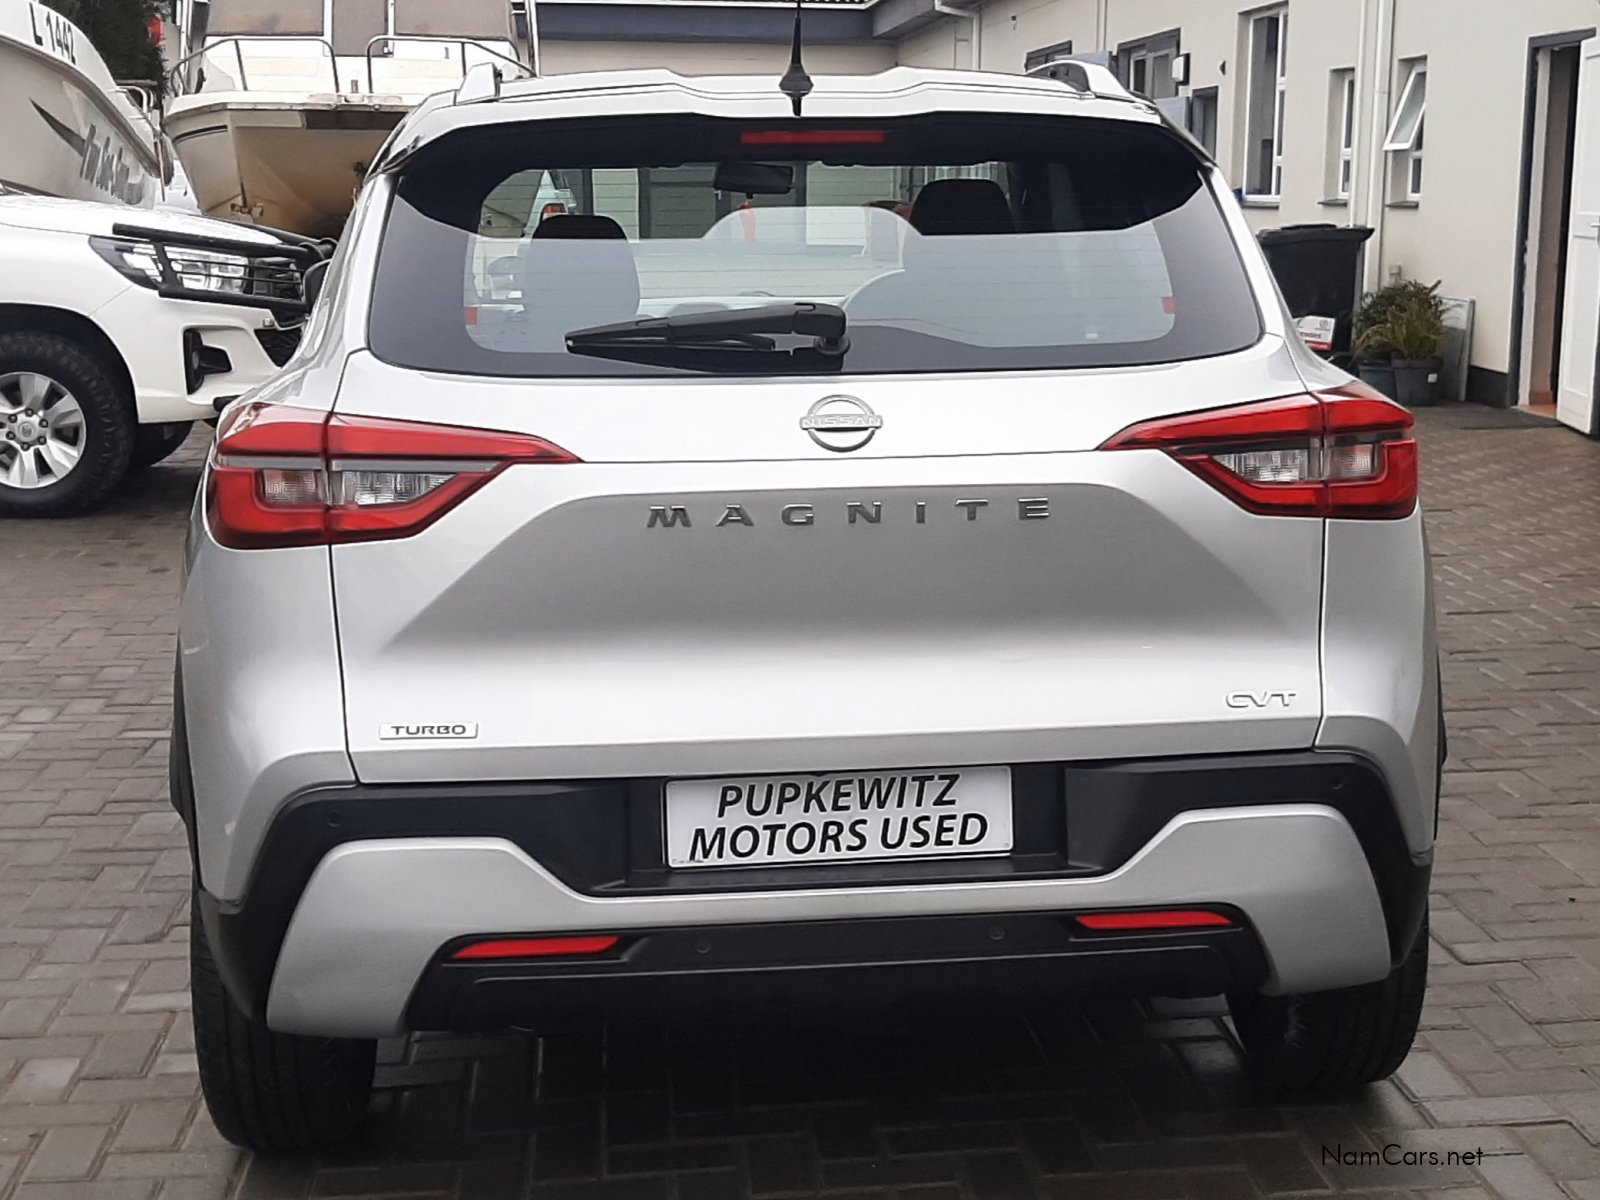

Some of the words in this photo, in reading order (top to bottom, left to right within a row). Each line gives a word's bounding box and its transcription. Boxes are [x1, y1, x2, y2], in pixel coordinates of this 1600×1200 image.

[29, 2, 44, 47] L
[46, 11, 76, 66] 1442
[801, 415, 881, 429] NISSAN
[646, 496, 1051, 528] MAGNITE
[1225, 690, 1297, 709] CVT
[390, 724, 467, 736] TURBO
[717, 773, 961, 818] PUPKEWITZ
[688, 818, 868, 861] MOTORS
[880, 812, 988, 850] USED
